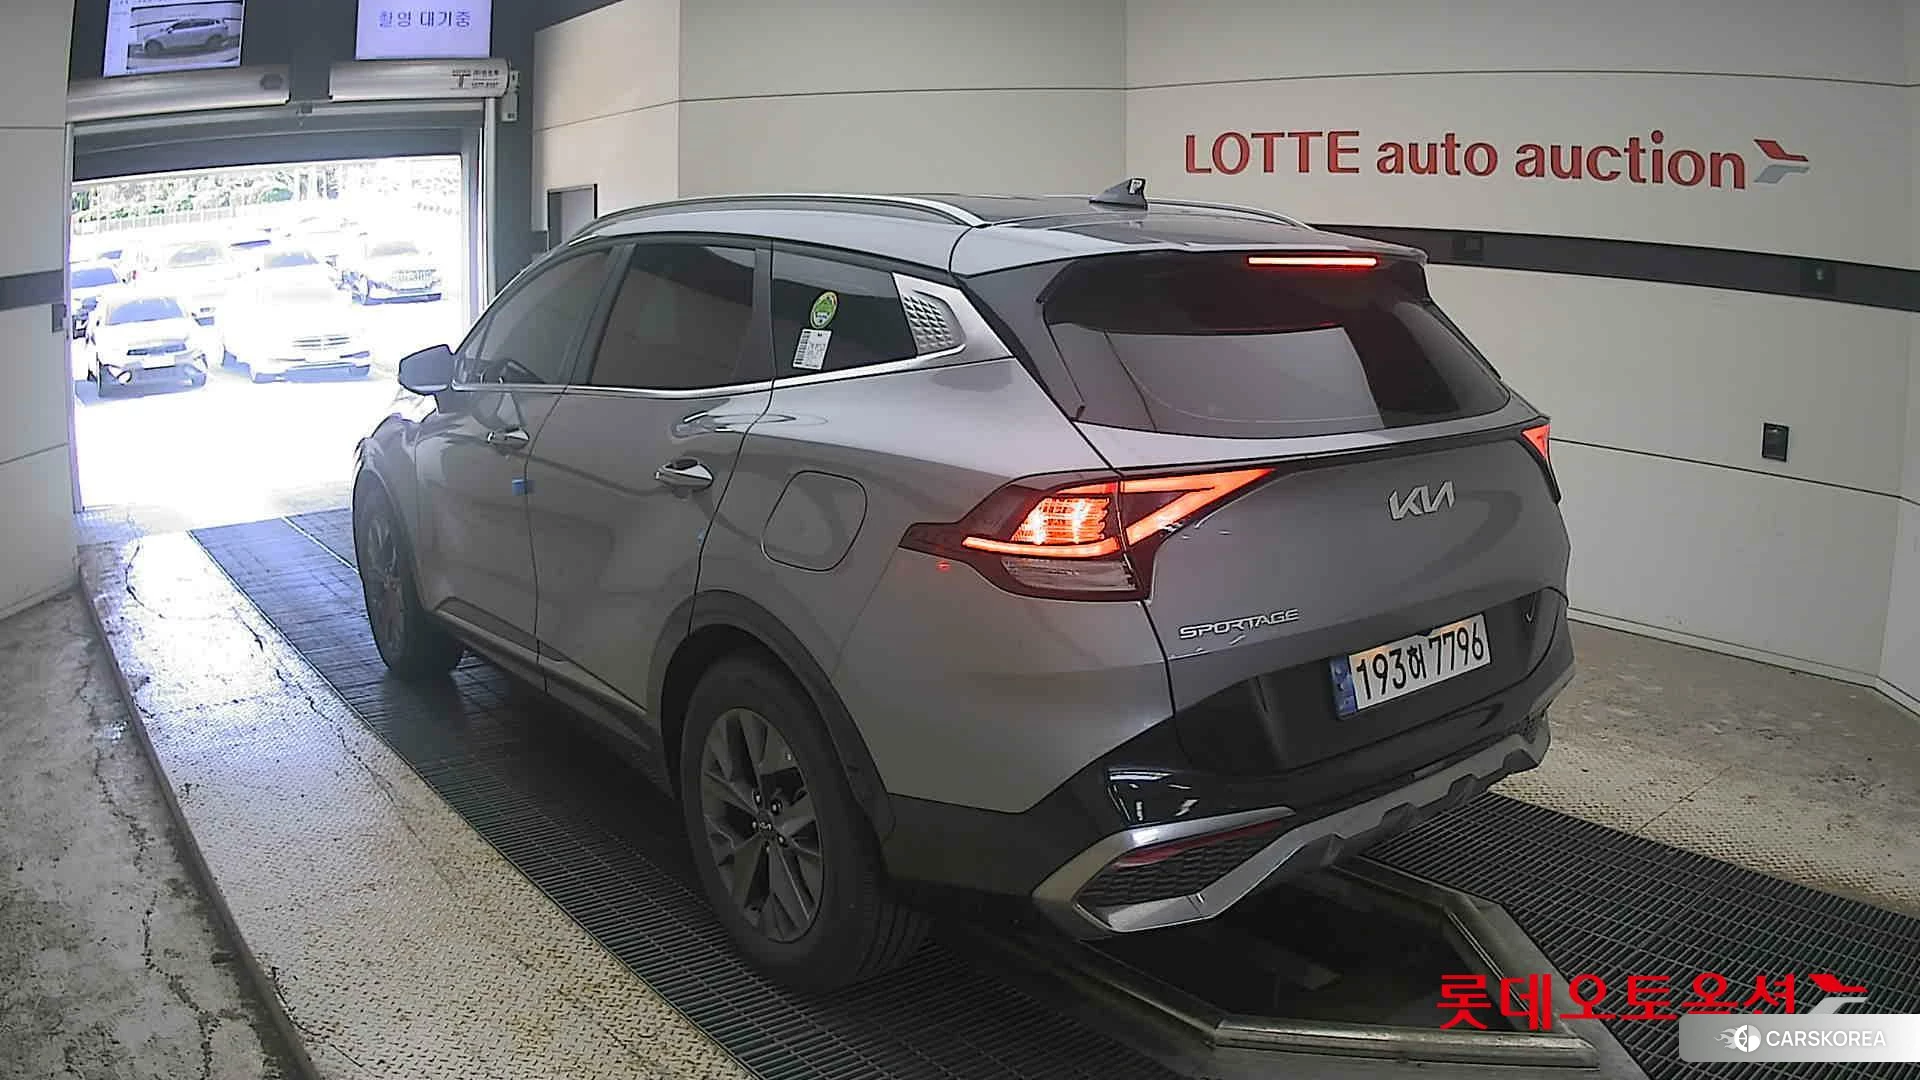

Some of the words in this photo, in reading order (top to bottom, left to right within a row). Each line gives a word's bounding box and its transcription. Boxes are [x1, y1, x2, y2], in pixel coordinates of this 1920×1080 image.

[420, 9, 471, 28] 대기중
[1185, 131, 1361, 175] LOTTE
[1376, 133, 1499, 177] auto
[1514, 131, 1747, 190] auction
[1178, 608, 1300, 640] SPORTAGE
